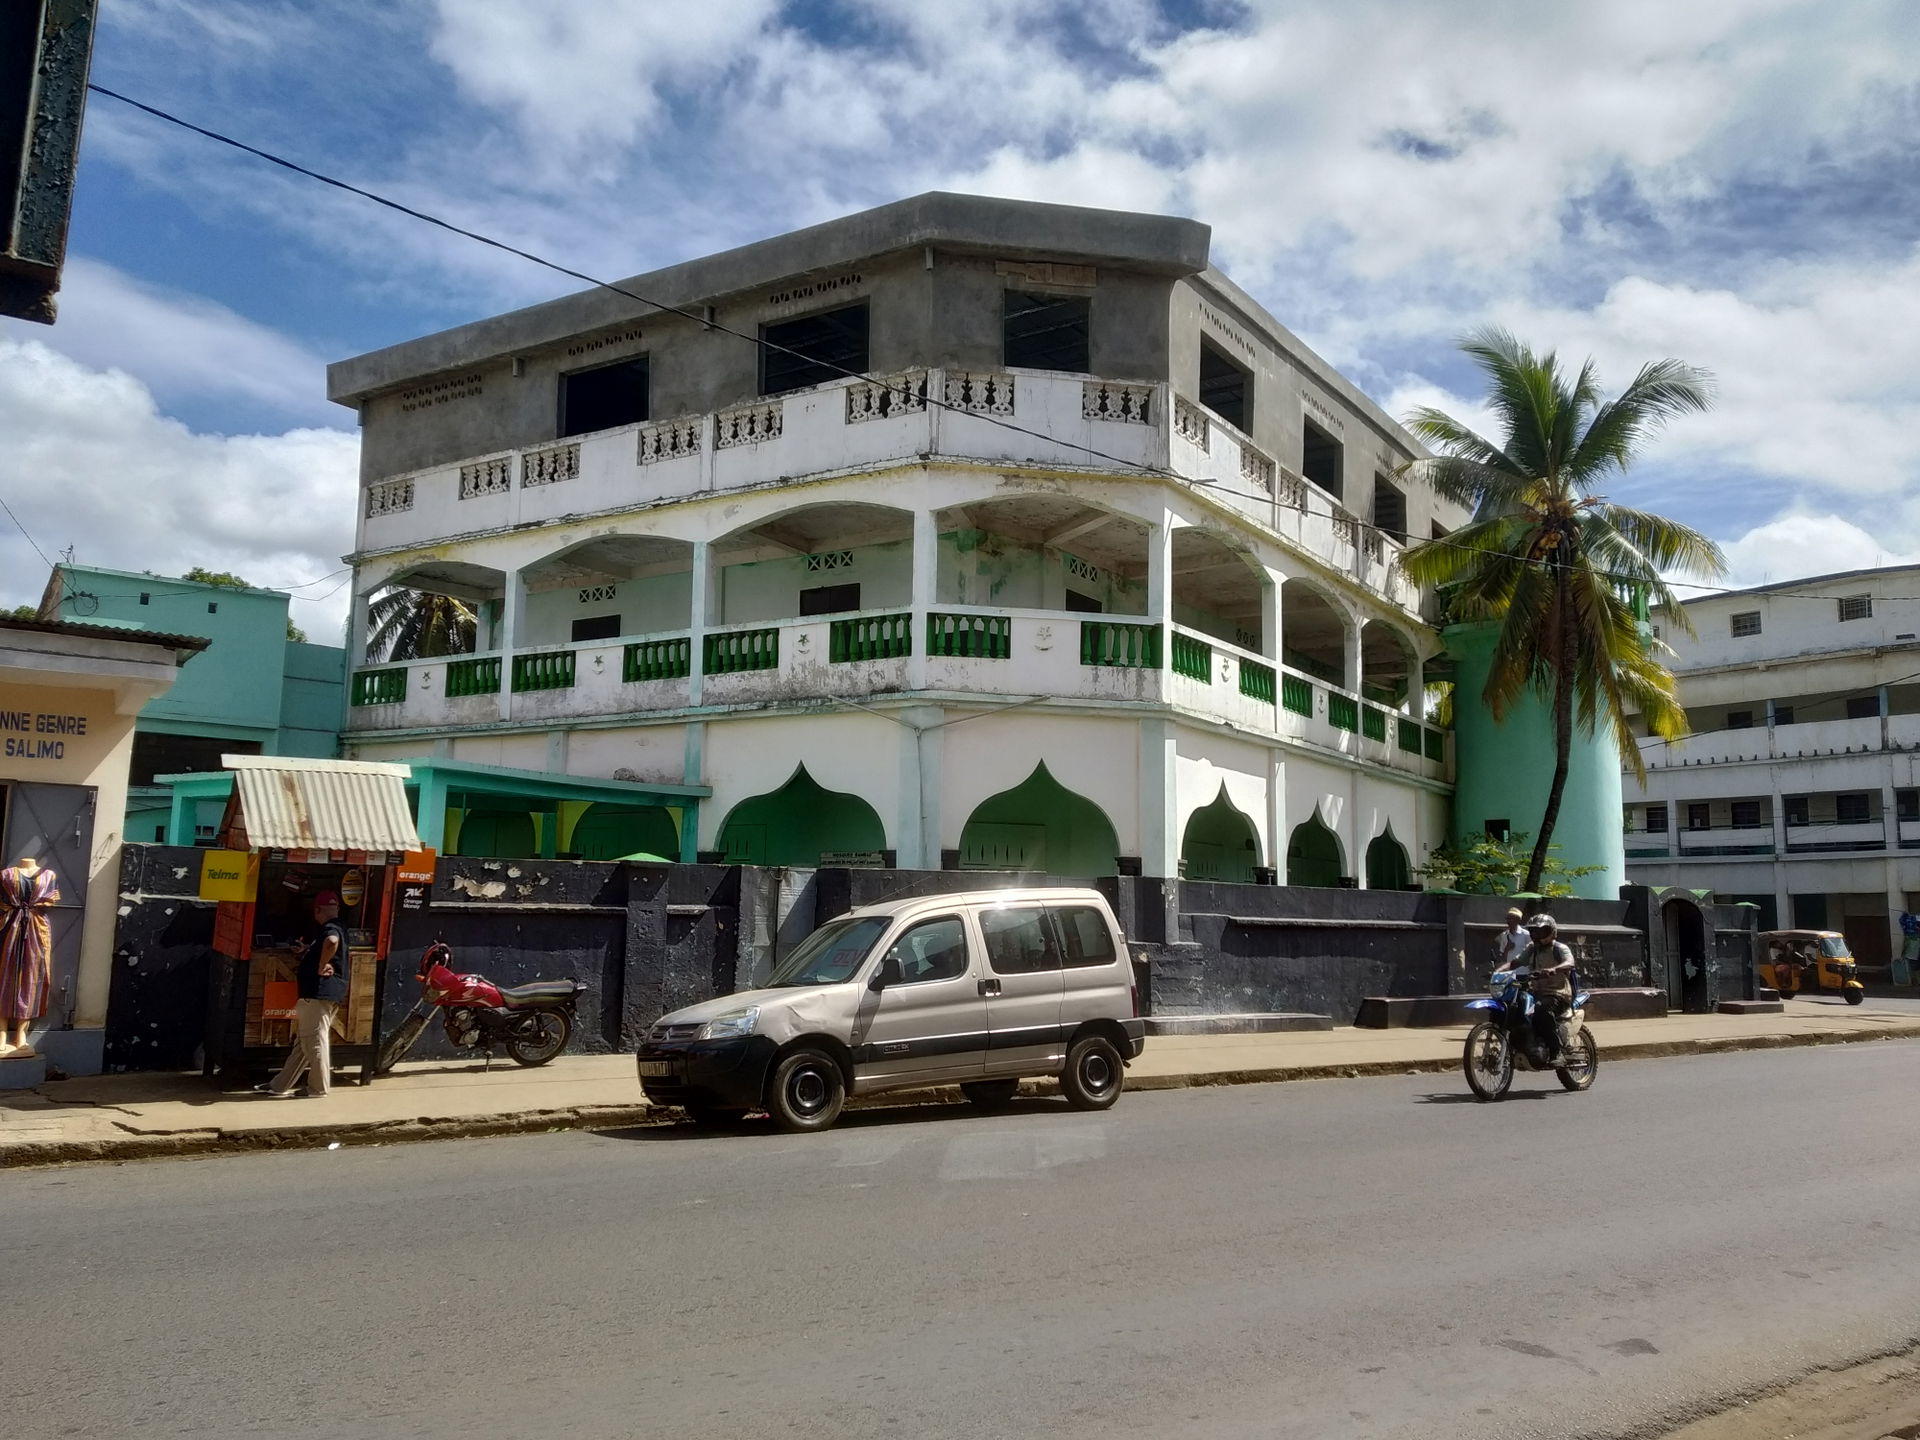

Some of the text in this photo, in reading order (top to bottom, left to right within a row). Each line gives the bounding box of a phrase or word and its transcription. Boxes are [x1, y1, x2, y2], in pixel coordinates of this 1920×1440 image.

[0, 711, 86, 735] NNE GENRE
[5, 738, 64, 759] SALIMO
[207, 868, 240, 881] Telma
[399, 871, 431, 882] orange
[264, 1008, 297, 1018] orange
